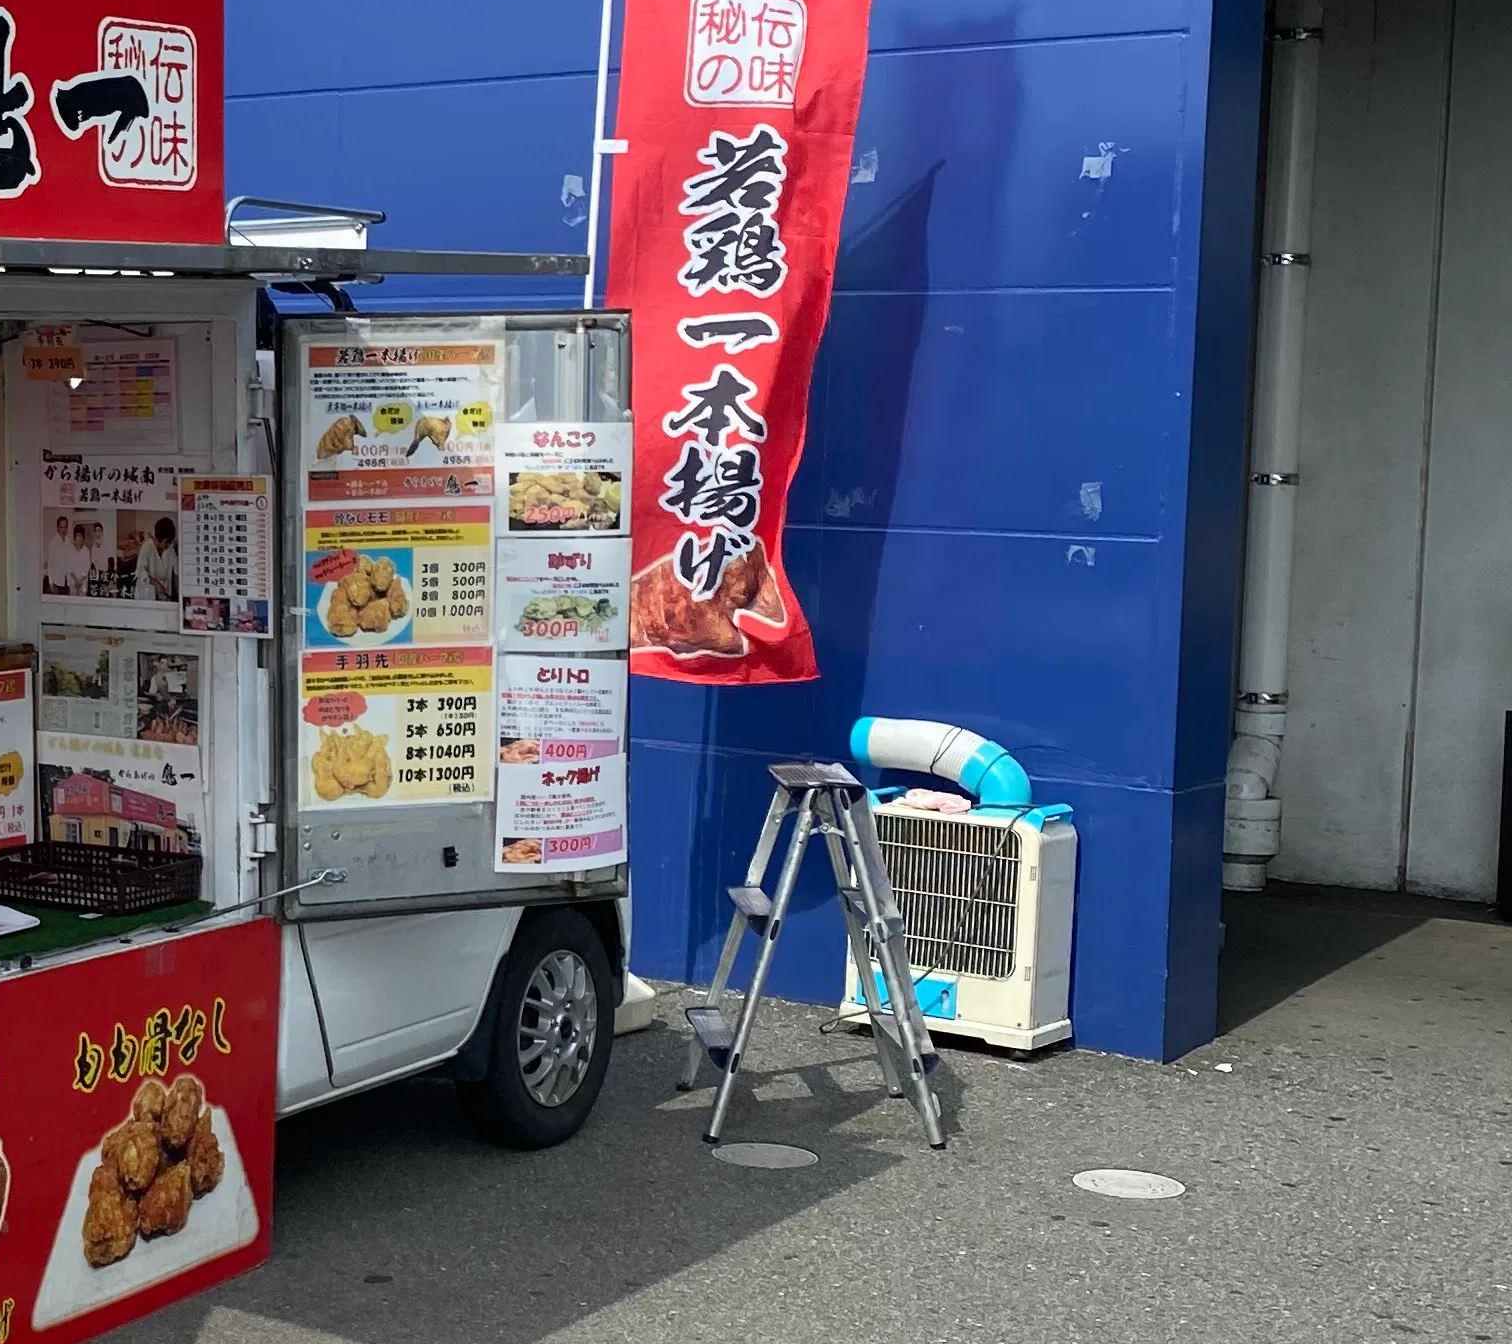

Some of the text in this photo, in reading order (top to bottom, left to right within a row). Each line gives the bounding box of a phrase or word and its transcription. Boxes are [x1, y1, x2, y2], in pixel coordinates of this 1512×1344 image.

[698, 0, 799, 50] 秘伝
[696, 53, 794, 100] の味
[336, 347, 422, 367] 若鶏一本揚げ
[660, 124, 788, 602] 若鶏一本揚げ
[533, 430, 597, 448] なんこつ
[421, 562, 486, 574] 3個 300円
[421, 575, 486, 588] 5個 500円
[421, 589, 486, 602] 8個 800円
[415, 605, 485, 618] 10個 1000円
[523, 620, 579, 637] 300円
[336, 654, 390, 670] 手羽先
[536, 667, 590, 684] とりトロ
[407, 696, 477, 713] 3本 390円
[406, 722, 476, 739] 5本 650円
[406, 744, 476, 761] 8本 1040円
[545, 744, 588, 758] 400円
[398, 766, 475, 783] 10本 1300円
[541, 765, 601, 786] ネック揚げ
[549, 836, 592, 853] 300円
[73, 999, 232, 1092] もも骨なし
